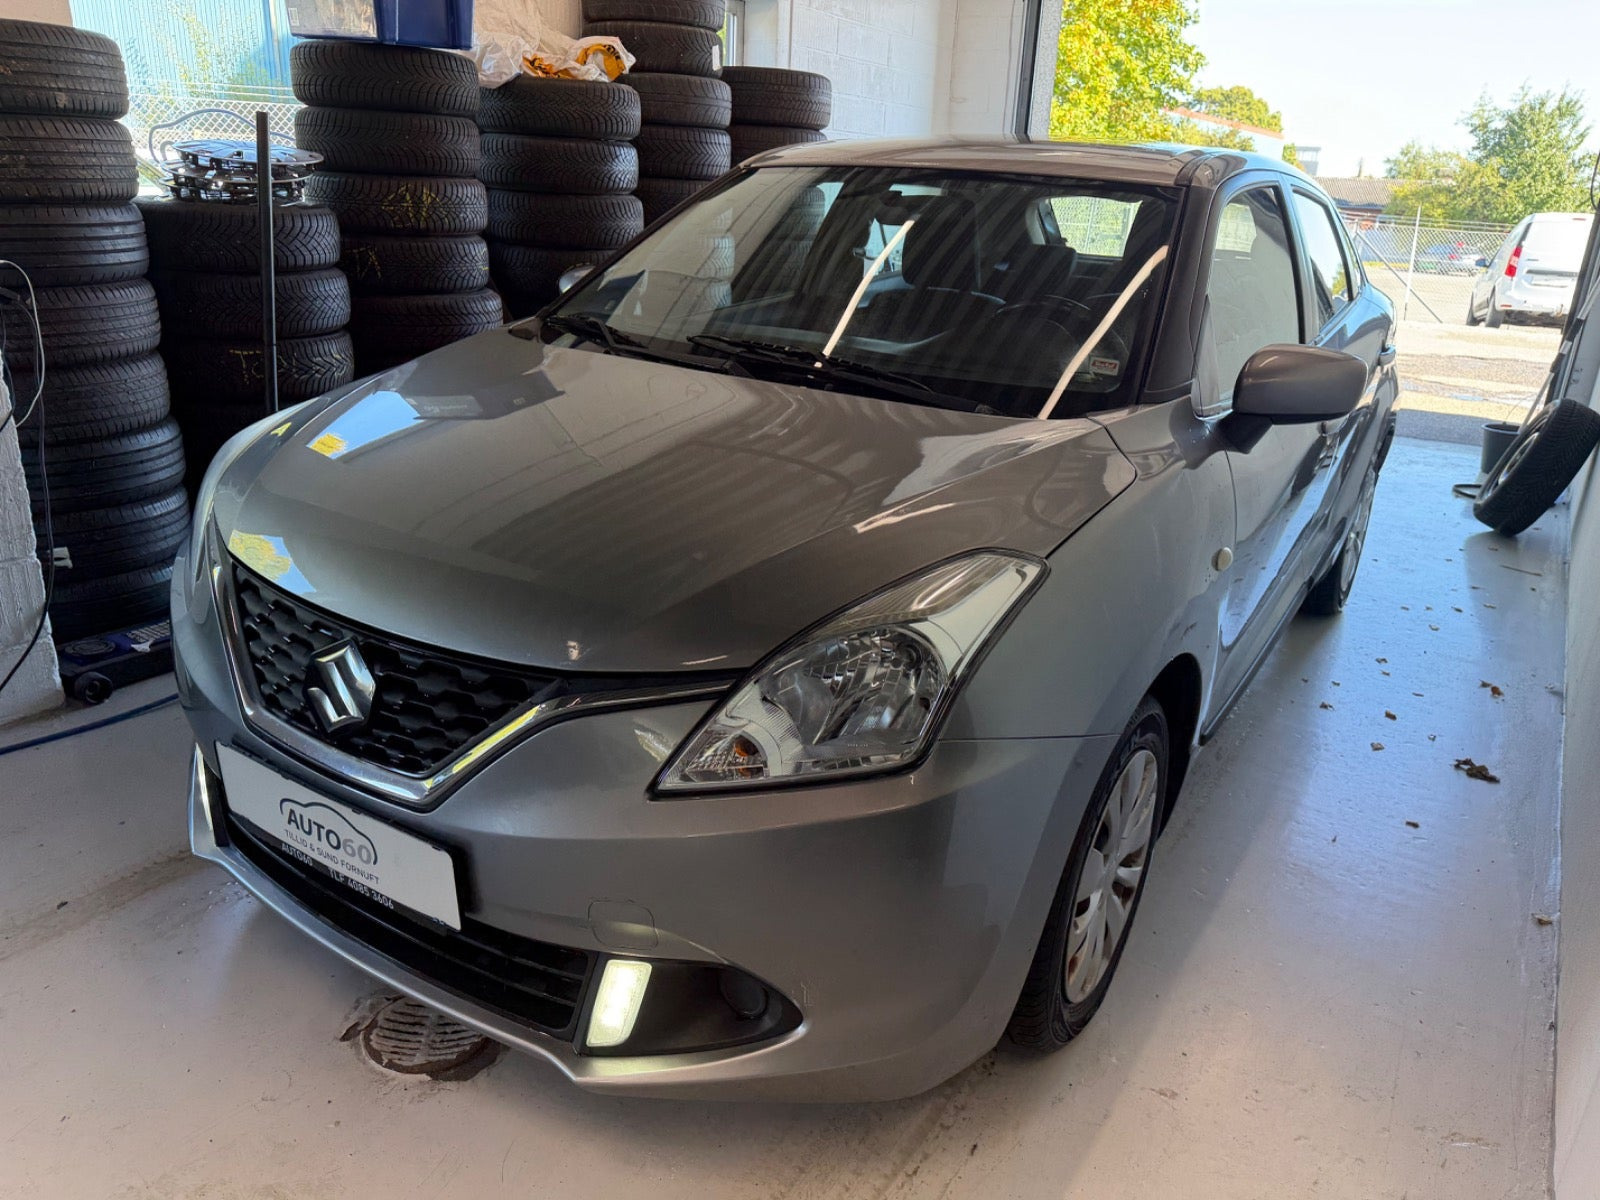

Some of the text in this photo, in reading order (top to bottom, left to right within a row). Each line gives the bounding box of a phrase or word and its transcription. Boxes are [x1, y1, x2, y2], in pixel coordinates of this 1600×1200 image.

[281, 842, 313, 867] AUTO60
[328, 866, 345, 882] TLF
[285, 829, 308, 848] TILLID
[316, 847, 339, 865] SUND
[341, 859, 379, 884] FORNUFT
[287, 808, 372, 865] AUTO60
